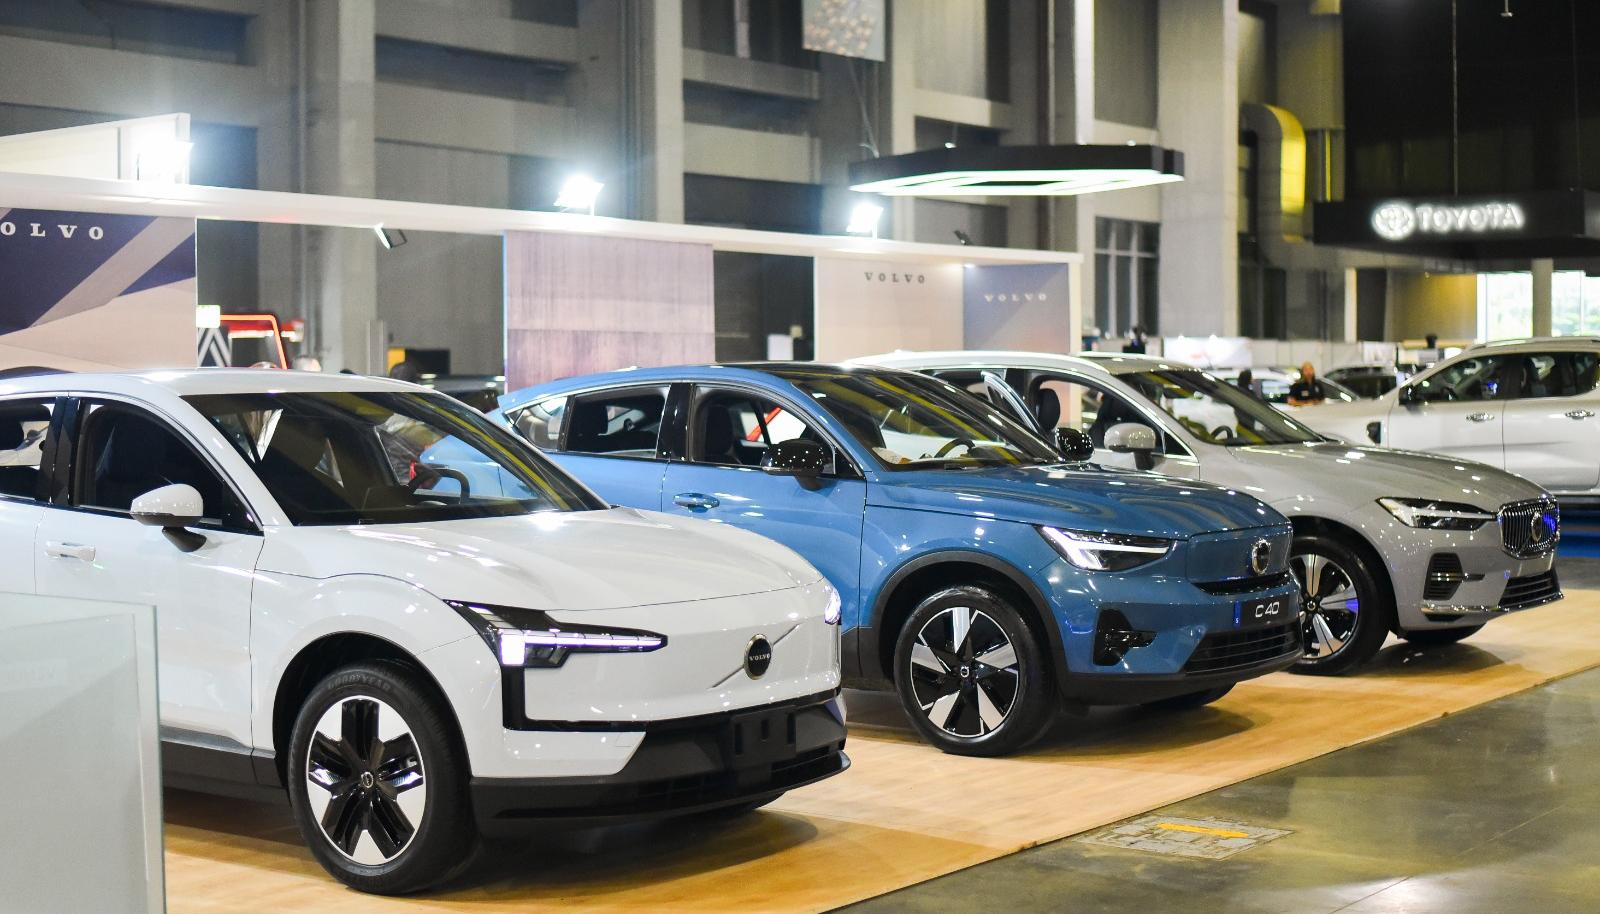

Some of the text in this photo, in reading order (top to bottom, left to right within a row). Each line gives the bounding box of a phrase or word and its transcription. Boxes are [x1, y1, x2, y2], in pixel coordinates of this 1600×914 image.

[1415, 203, 1525, 232] TOYOTA
[864, 271, 925, 284] VOLVO
[984, 292, 1048, 303] VOLVO
[748, 653, 771, 662] VOLVO
